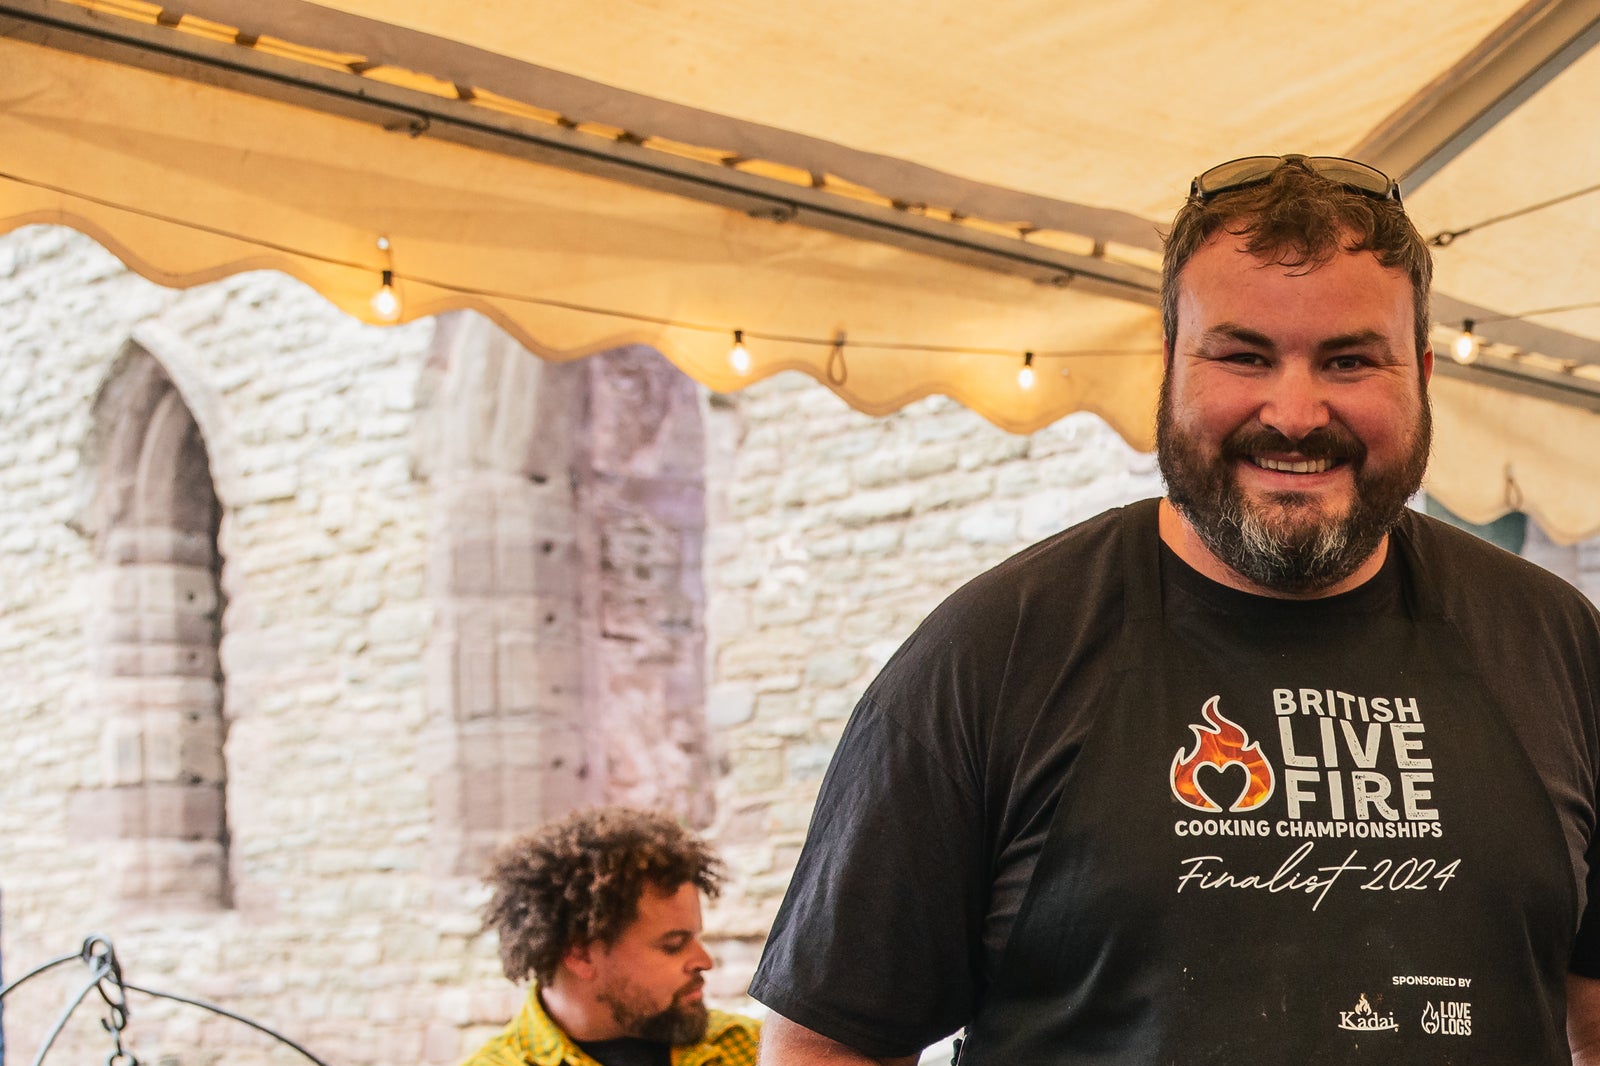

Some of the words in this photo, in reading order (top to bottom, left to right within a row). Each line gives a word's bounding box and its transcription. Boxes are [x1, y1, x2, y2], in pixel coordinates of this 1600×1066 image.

[1272, 688, 1422, 722] BRITISH
[1277, 716, 1433, 769] LIVE
[1284, 768, 1440, 820] FIRE
[1174, 819, 1271, 837] COOKING
[1275, 820, 1443, 838] CHAMPIONSHIPS
[1177, 841, 1367, 911] Finalist
[1360, 857, 1461, 892] 2024
[1392, 975, 1456, 987] SPONSORED
[1458, 977, 1472, 988] BY
[1440, 1001, 1472, 1019] LOVE
[1339, 1011, 1395, 1029] Kadai
[1441, 1018, 1472, 1036] LOGS
